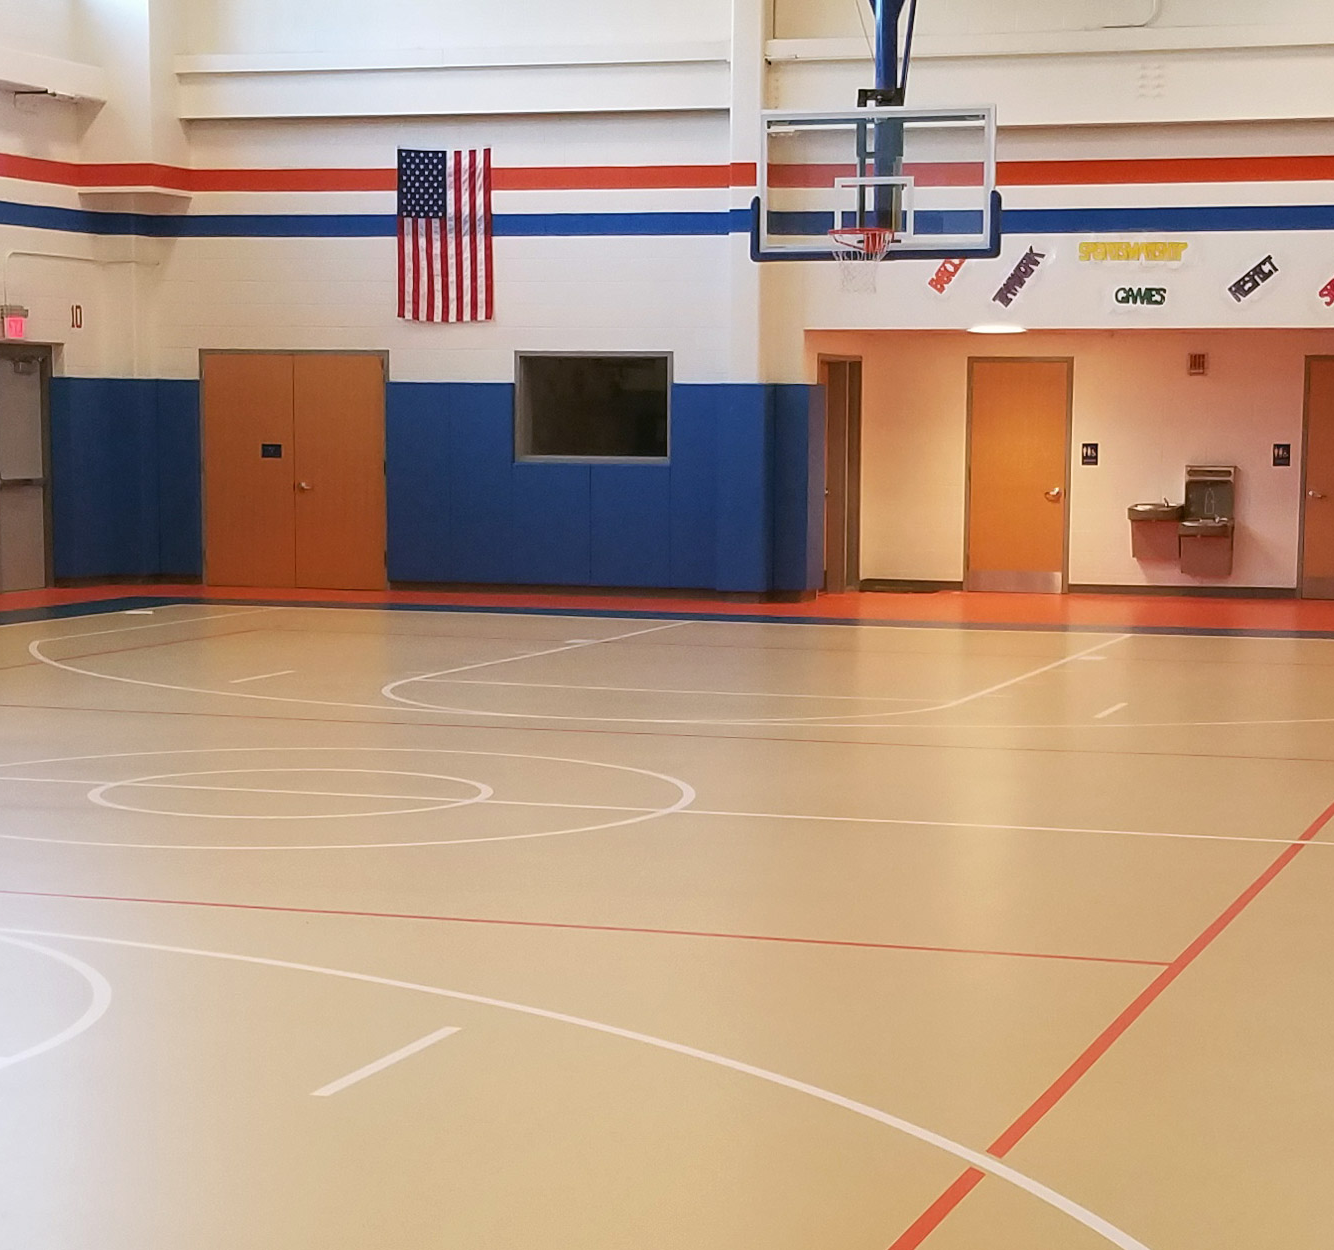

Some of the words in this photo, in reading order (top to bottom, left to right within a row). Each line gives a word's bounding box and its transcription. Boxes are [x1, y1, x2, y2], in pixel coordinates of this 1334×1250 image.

[992, 245, 1046, 308] TEAMWORK
[1227, 254, 1279, 303] RESPECT
[1115, 287, 1167, 305] GAMES
[71, 304, 83, 328] 10
